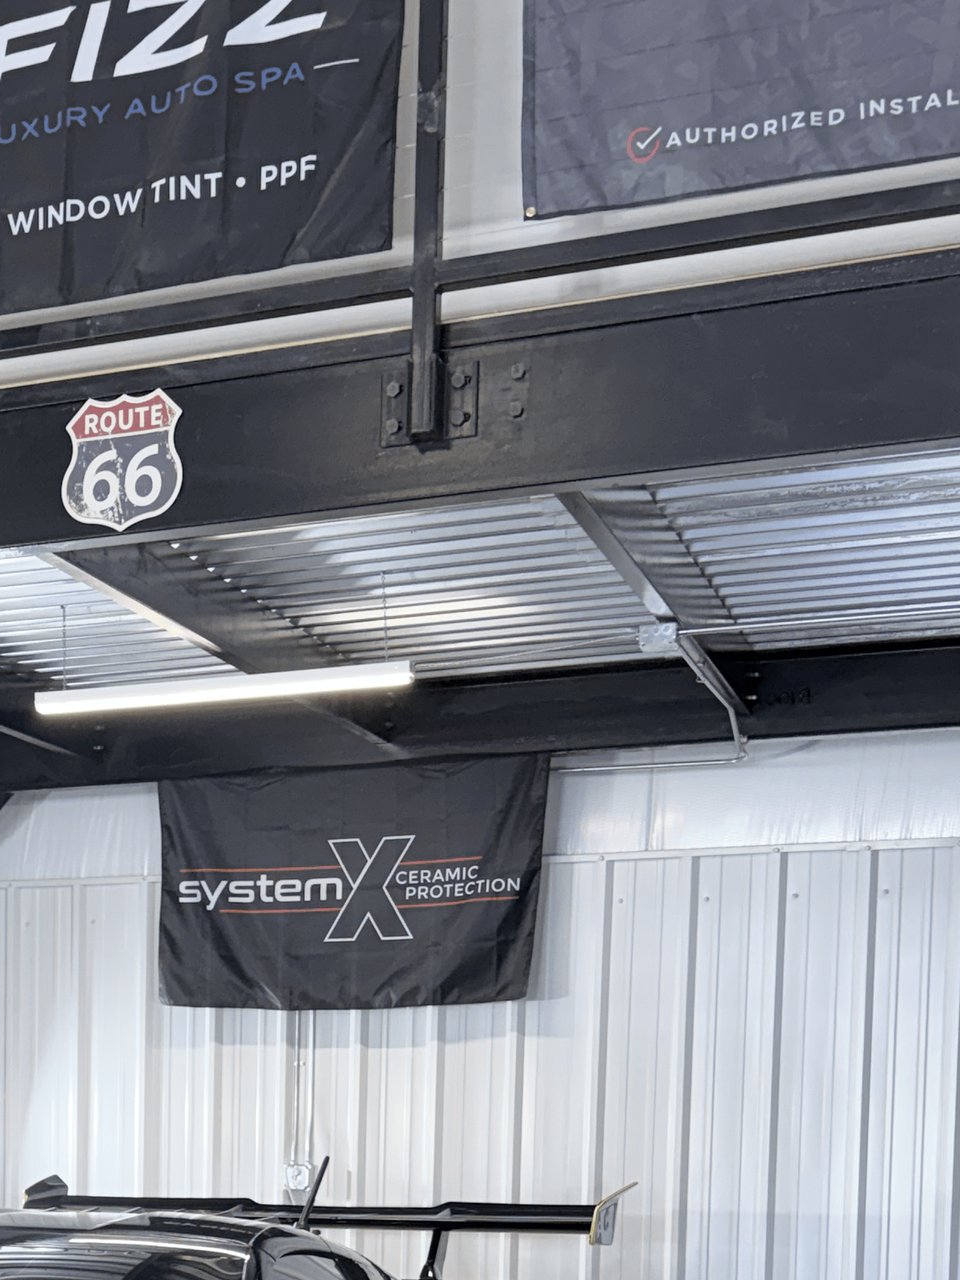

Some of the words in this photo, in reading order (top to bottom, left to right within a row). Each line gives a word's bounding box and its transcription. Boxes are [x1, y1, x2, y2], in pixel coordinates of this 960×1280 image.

[123, 74, 218, 119] AUTO
[234, 62, 305, 93] SPA
[665, 108, 846, 149] AUTHORIZED
[859, 88, 959, 120] INSTAL
[7, 187, 142, 237] WINDOW
[150, 171, 222, 204] TINT
[259, 155, 317, 191] PPF
[84, 403, 163, 435] ROUTE
[82, 443, 162, 512] 66
[395, 865, 480, 886] CERAMIC
[405, 877, 521, 901] PROTECTION
